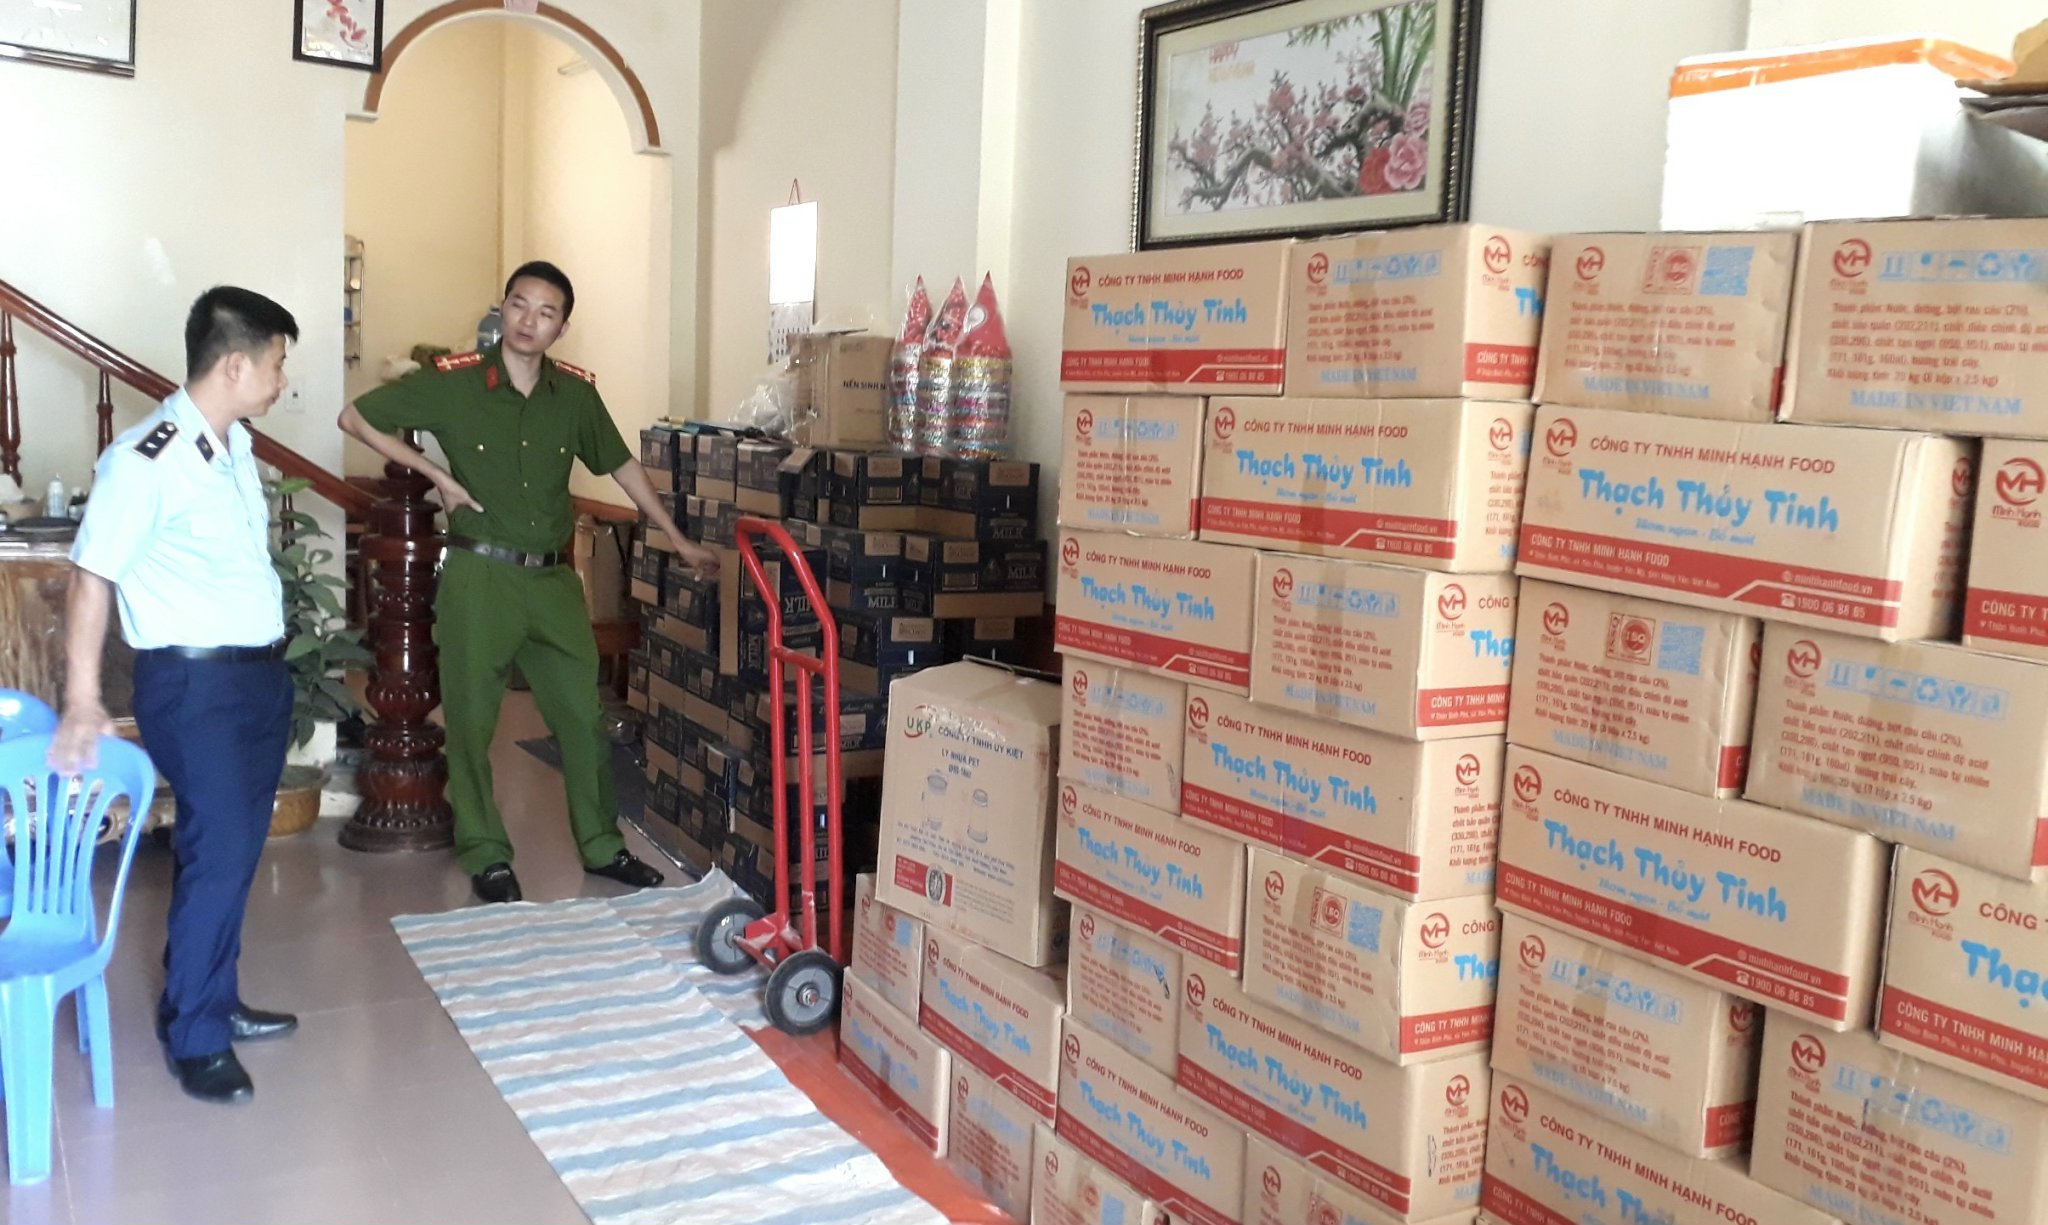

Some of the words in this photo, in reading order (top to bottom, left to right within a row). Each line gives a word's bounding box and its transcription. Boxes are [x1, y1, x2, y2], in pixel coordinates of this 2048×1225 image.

[1097, 275, 1122, 287] CÔNG
[1124, 275, 1135, 285] TY
[1137, 274, 1161, 284] TNHH
[1162, 272, 1186, 283] MINH
[1216, 268, 1243, 280] FOOD
[1090, 303, 1145, 333] Thạch
[1150, 300, 1196, 331] Thủy
[1202, 298, 1247, 321] Tinh
[1850, 388, 1898, 407] MADE
[1905, 391, 1924, 409] IN
[1978, 395, 2022, 415] NAM
[1243, 419, 1270, 432] CÔNG
[1272, 421, 1284, 432] TY
[1287, 422, 1315, 433] TNHH
[1315, 423, 1342, 435] MINH
[1377, 425, 1408, 438] FOOD
[1235, 448, 1295, 485] Thạch
[1301, 453, 1353, 490] Thủy
[1359, 456, 1412, 486] Tinh
[1589, 435, 1629, 453] CÔNG
[1634, 441, 1651, 454] TY
[1655, 443, 1694, 458] TNHH
[1696, 448, 1737, 463] MINH
[1739, 452, 1784, 468] HẠNH
[1788, 456, 1835, 474] FOOD
[1578, 467, 1665, 515] Thạch
[1675, 479, 1751, 528] Thủy
[1763, 489, 1838, 531] Tinh
[993, 527, 1023, 539] MILK
[1530, 533, 1553, 548] CÔNG
[1555, 536, 1566, 549] TY
[1568, 539, 1590, 553] TNHH
[1592, 543, 1615, 557] MINH
[1617, 547, 1642, 562] HẠNH
[1644, 551, 1669, 567] FOOD
[1008, 566, 1037, 579] MILK
[1085, 550, 1106, 563] CÔNG
[1107, 554, 1117, 564] TY
[1118, 556, 1140, 568] TNHH
[1140, 559, 1161, 571] MINH
[1187, 566, 1211, 579] FOOD
[1080, 575, 1126, 608] Thạch
[1129, 583, 1171, 619] Thủy
[1175, 591, 1214, 619] Tinh
[1478, 594, 1511, 609] CÔNG
[1981, 599, 2015, 617] CÔNG
[2020, 604, 2036, 619] TY
[1430, 695, 1452, 708] CÔNG
[1454, 695, 1464, 706] TY
[1466, 694, 1485, 705] TNHH
[1486, 693, 1504, 704] MINH
[907, 716, 931, 733] UKP
[1216, 715, 1242, 731] CÔNG
[1243, 722, 1255, 734] TY
[1257, 726, 1282, 742] TNHH
[1284, 733, 1309, 749] MINH
[1342, 747, 1371, 765] FOOD
[942, 748, 949, 758] LY
[968, 755, 980, 767] PET
[972, 736, 993, 750] TNHH
[1210, 741, 1267, 782] Thạch
[1272, 759, 1321, 803] Thủy
[1327, 775, 1376, 813] Tinh
[1553, 788, 1589, 809] CÔNG
[1593, 799, 1609, 814] TY
[1613, 805, 1650, 827] TNHH
[1653, 816, 1689, 837] MINH
[1691, 828, 1734, 849] HẠNH
[1737, 839, 1781, 863] FOOD
[1543, 819, 1625, 871] Thạch
[1633, 847, 1705, 903] Thủy
[1715, 870, 1786, 921] Tinh
[1505, 872, 1525, 888] CÔNG
[1527, 879, 1536, 891] TY
[1539, 884, 1559, 900] TNHH
[1561, 891, 1582, 908] MINH
[1584, 900, 1607, 917] HẠNH
[1609, 908, 1632, 926] FOOD
[1978, 902, 2037, 930] CÔNG
[1462, 916, 1495, 934] CÔNG
[1750, 974, 1772, 993] 1900
[1773, 982, 1786, 998] 06
[1801, 992, 1815, 1008] 85
[1212, 997, 1236, 1018] CÔNG
[1238, 1010, 1249, 1024] TY
[1251, 1016, 1276, 1038] TNHH
[1277, 1031, 1301, 1051] MINH
[1333, 1058, 1362, 1080] FOOD
[1414, 1020, 1435, 1034] CÔNG
[1438, 1019, 1447, 1030] TY
[1449, 1016, 1469, 1028] TNHH
[1897, 1000, 1928, 1023] CÔNG
[1933, 1012, 1948, 1028] TY
[1952, 1019, 1985, 1041] TNHH
[1989, 1032, 2022, 1055] MINH
[1205, 1023, 1259, 1071] Thạch
[1263, 1055, 1313, 1106] Thủy
[1318, 1083, 1366, 1127] Tinh
[1529, 1142, 1607, 1208] Thạch
[1539, 1114, 1574, 1141] CÔNG
[1577, 1132, 1593, 1149] TY
[1596, 1142, 1631, 1169] TNHH
[1634, 1162, 1668, 1188] MINH
[1671, 1182, 1712, 1210] HẠNH
